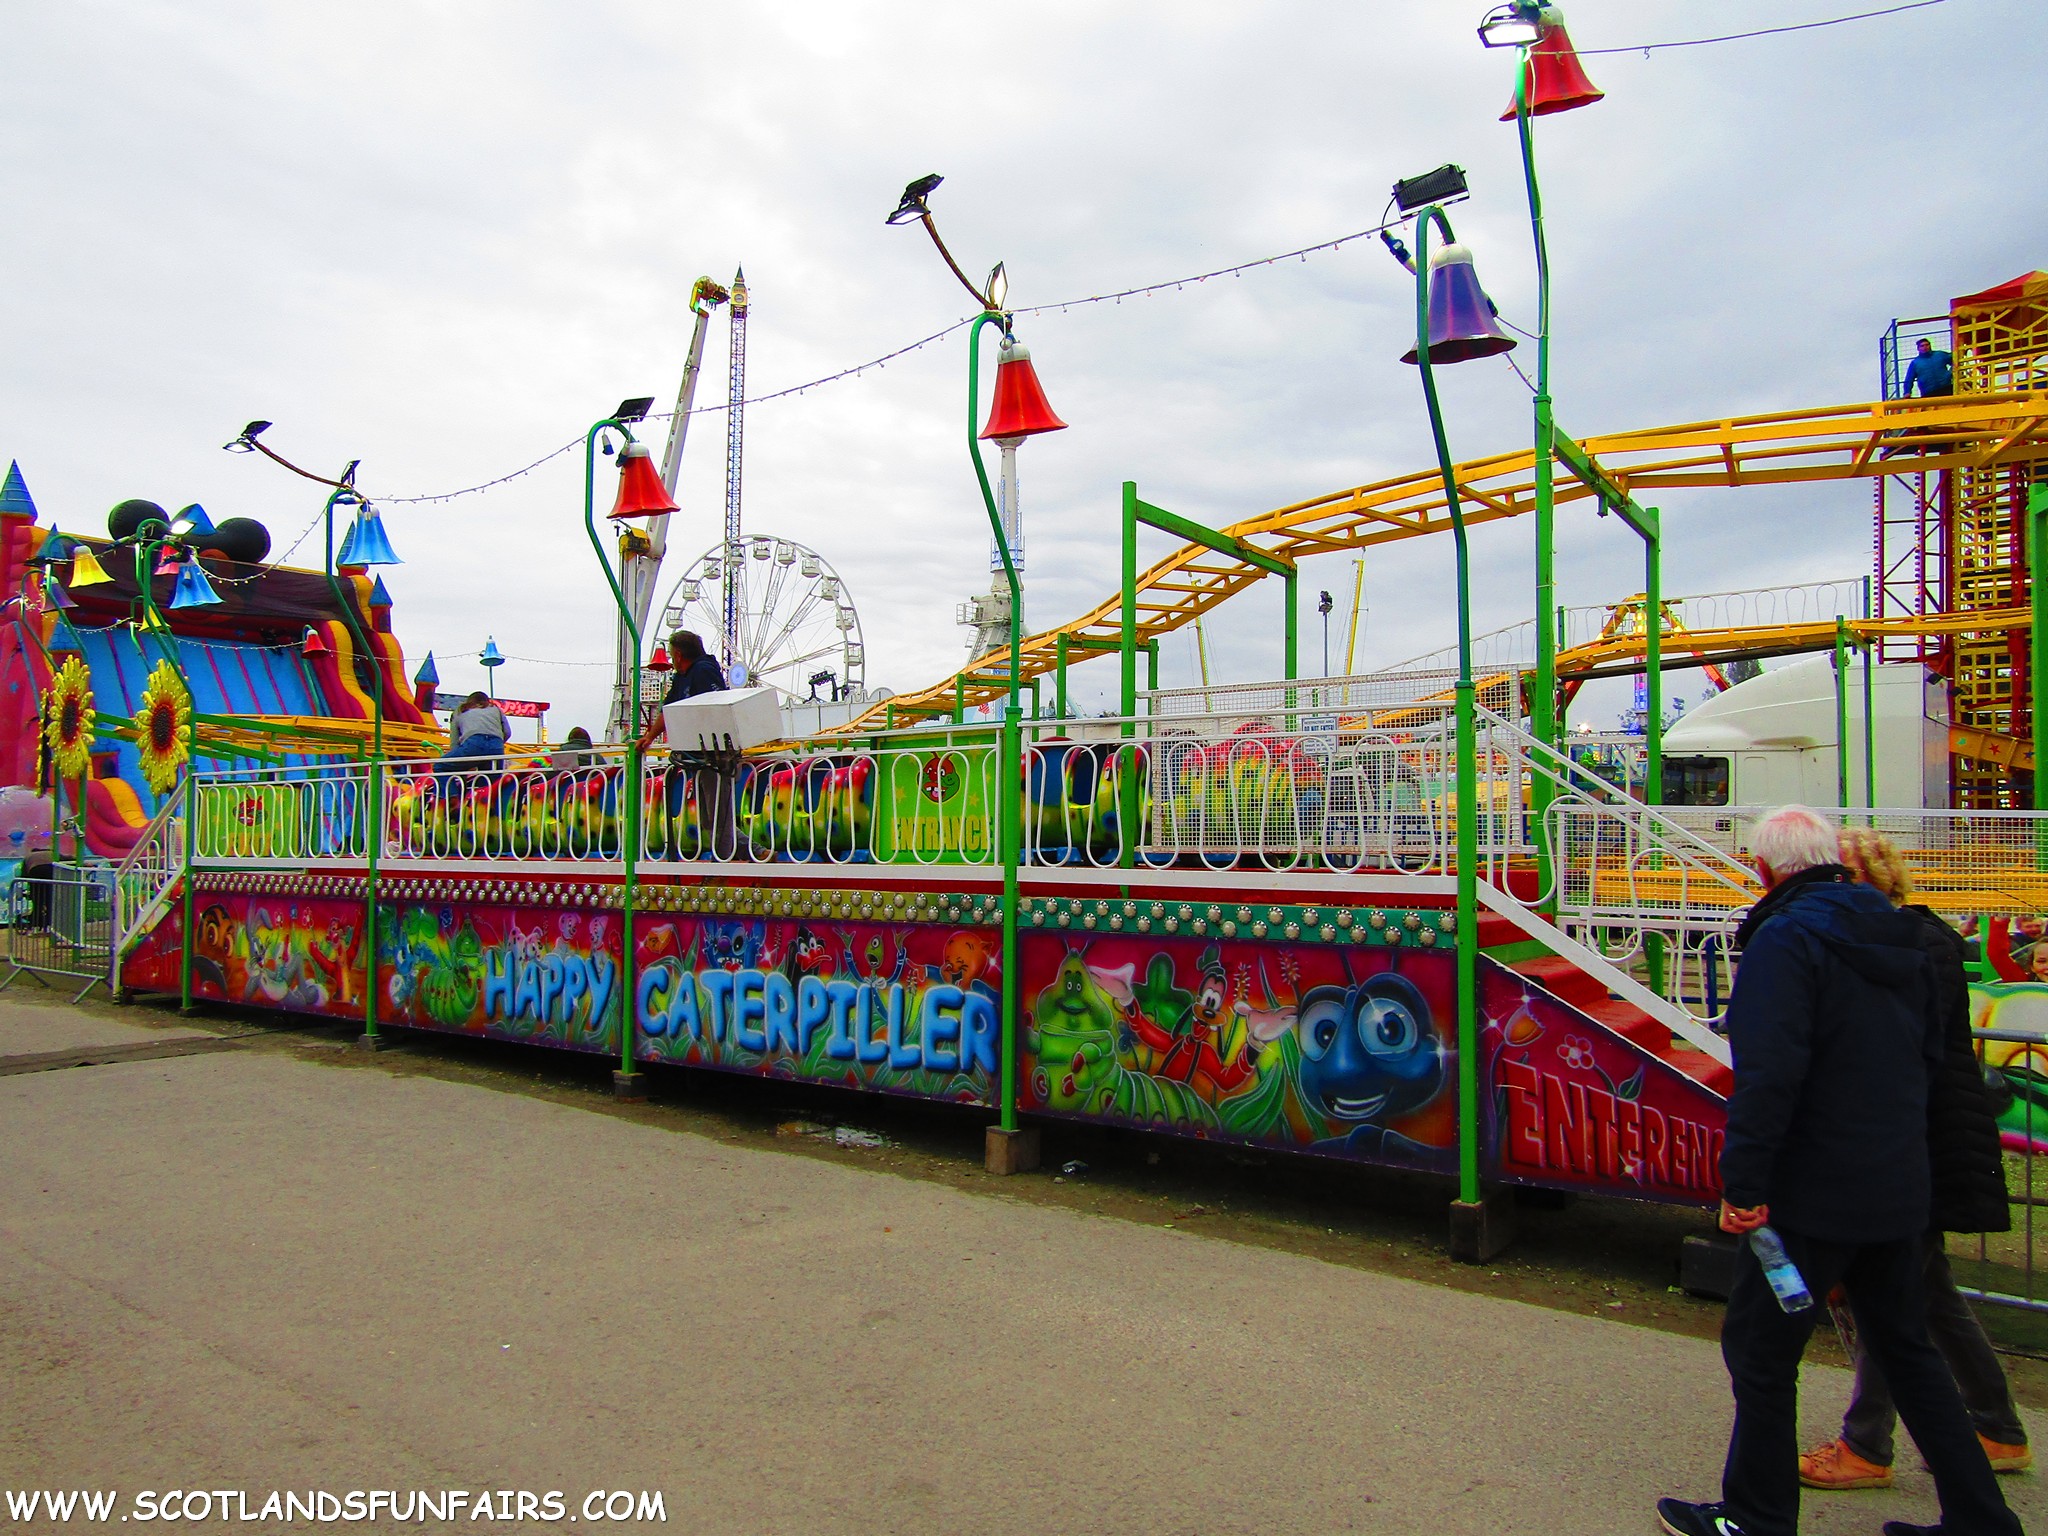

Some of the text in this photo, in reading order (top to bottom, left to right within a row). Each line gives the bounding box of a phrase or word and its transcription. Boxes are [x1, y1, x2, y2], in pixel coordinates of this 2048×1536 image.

[891, 814, 993, 853] ENTRANCE
[485, 949, 996, 1072] HAPPY CATERPILLER
